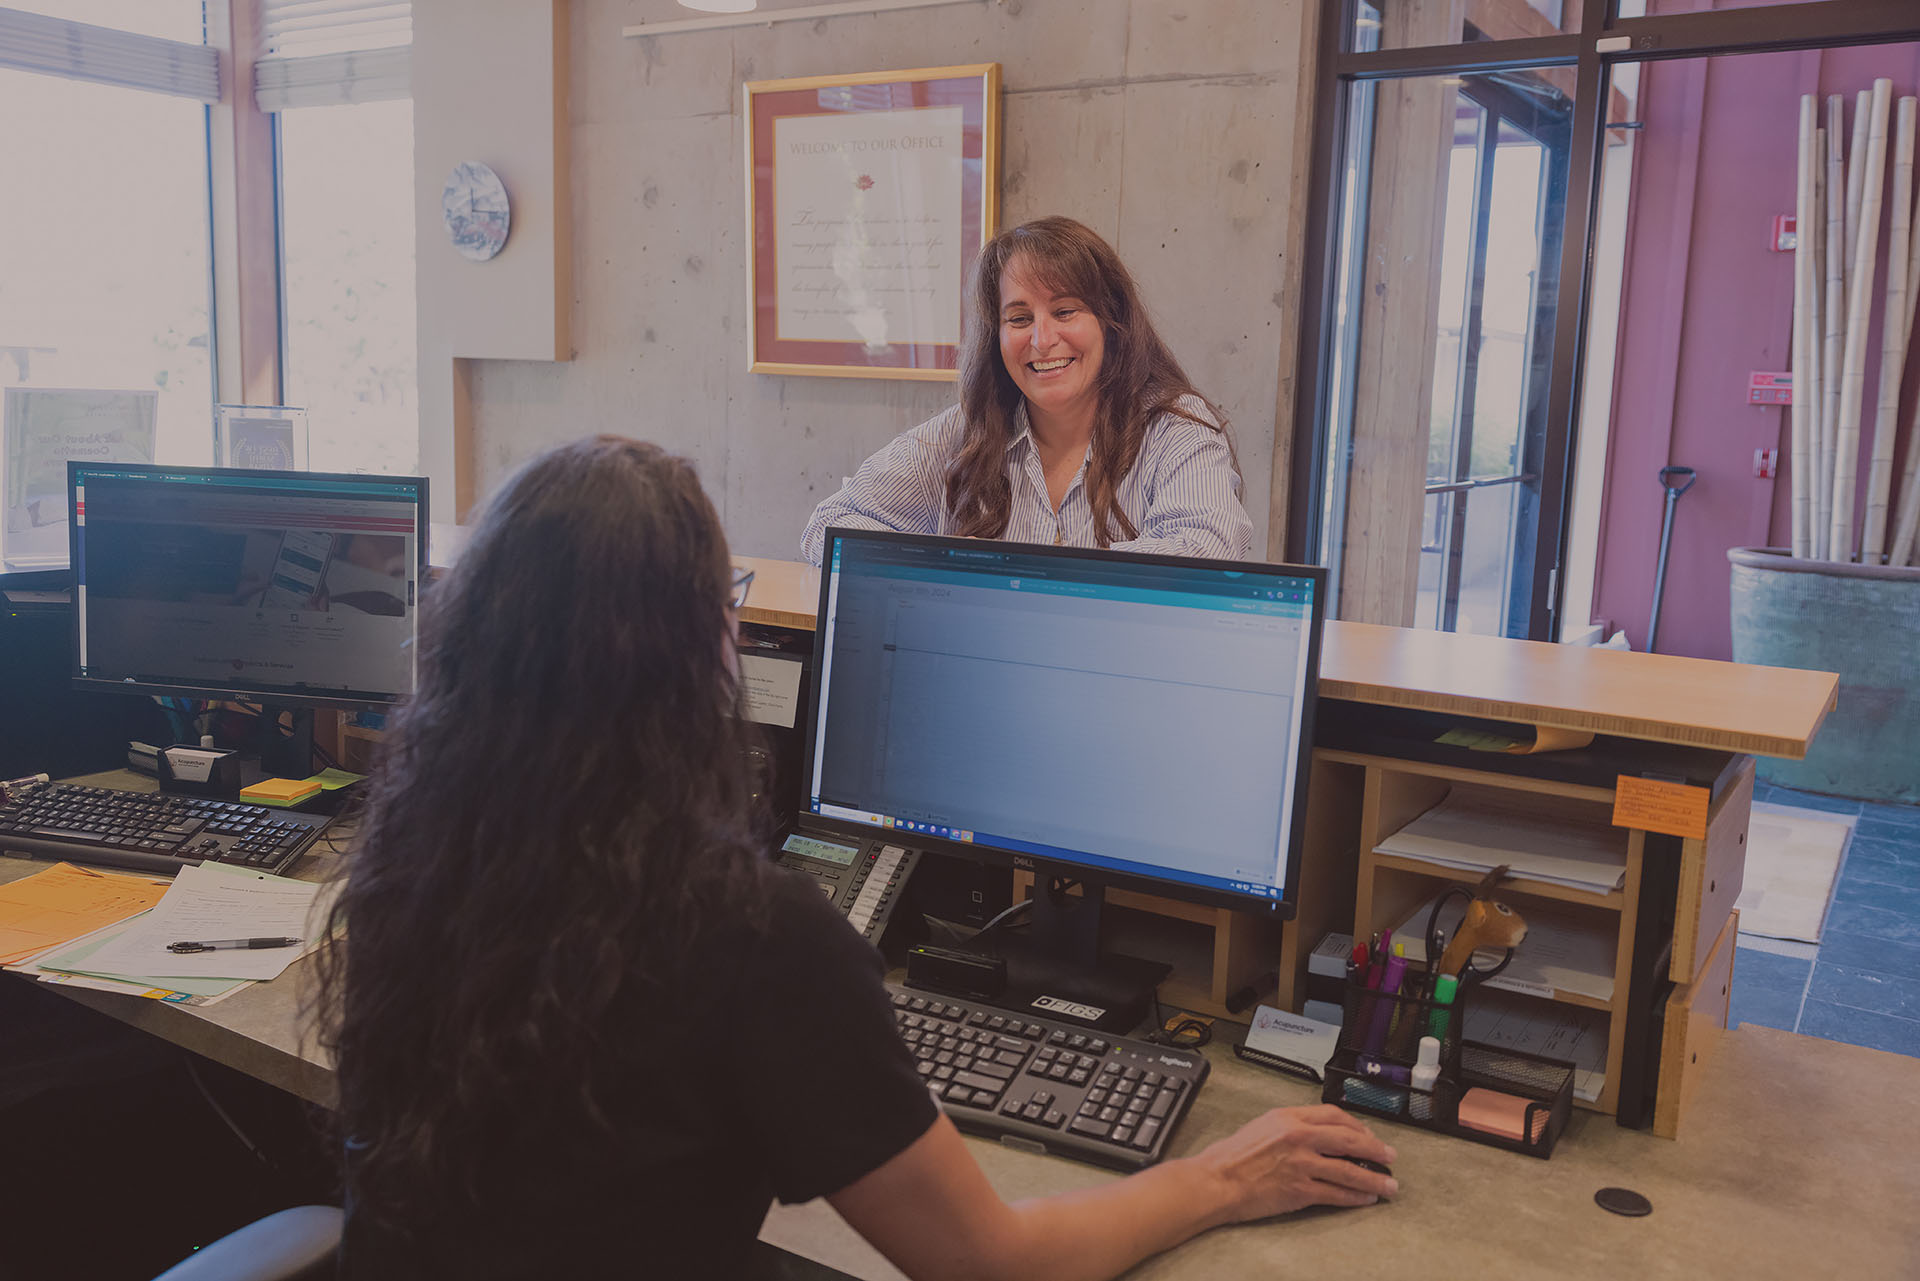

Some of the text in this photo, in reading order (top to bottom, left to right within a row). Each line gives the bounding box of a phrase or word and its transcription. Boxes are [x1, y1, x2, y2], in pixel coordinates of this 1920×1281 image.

[790, 135, 945, 155] WELCOME TO OUR OFFICE
[1013, 856, 1035, 868] DELL
[1049, 1000, 1102, 1018] FIGS
[1272, 1018, 1316, 1034] Acupuncture
[1159, 1055, 1193, 1069] logitech
